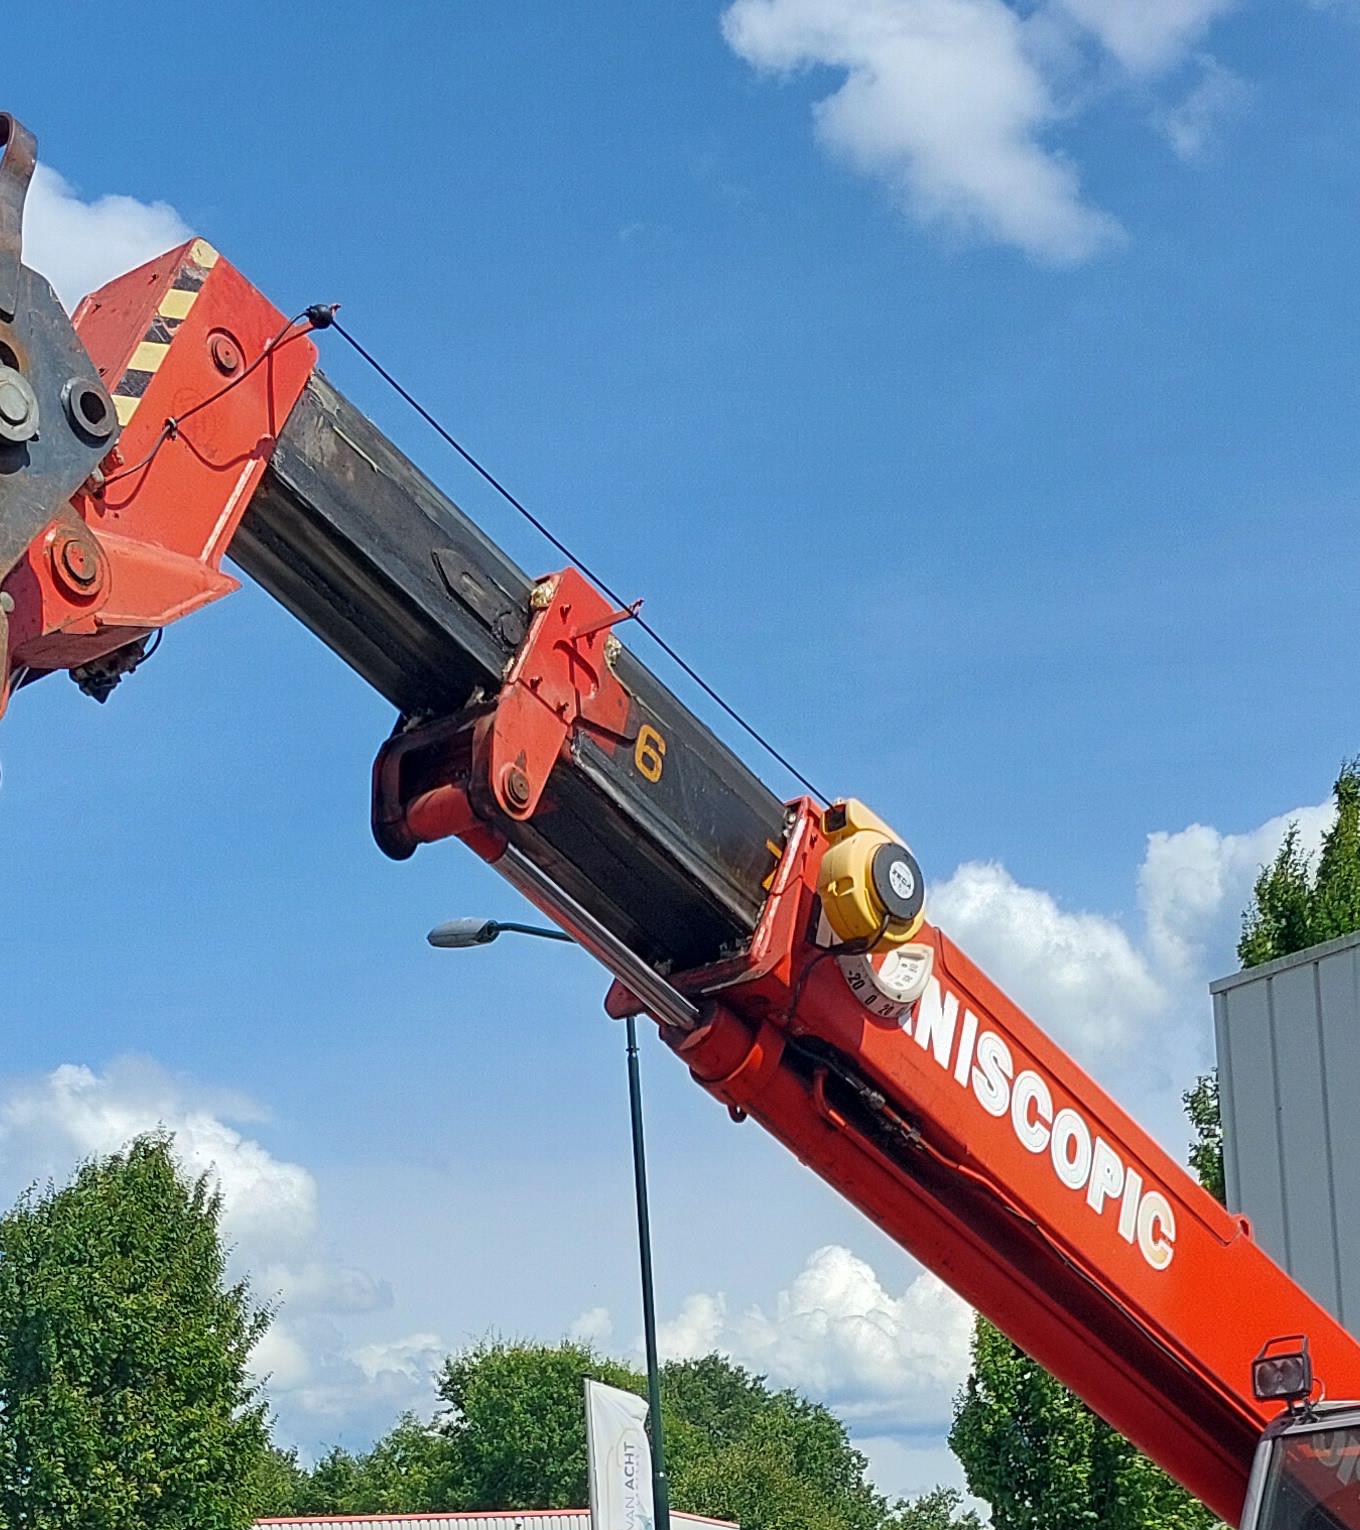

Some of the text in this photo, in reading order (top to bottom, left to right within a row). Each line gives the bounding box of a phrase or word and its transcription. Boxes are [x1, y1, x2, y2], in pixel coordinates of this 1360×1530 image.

[634, 724, 666, 783] 6
[816, 905, 1176, 1271] NISCOPIC
[624, 1441, 635, 1491] ACHT
